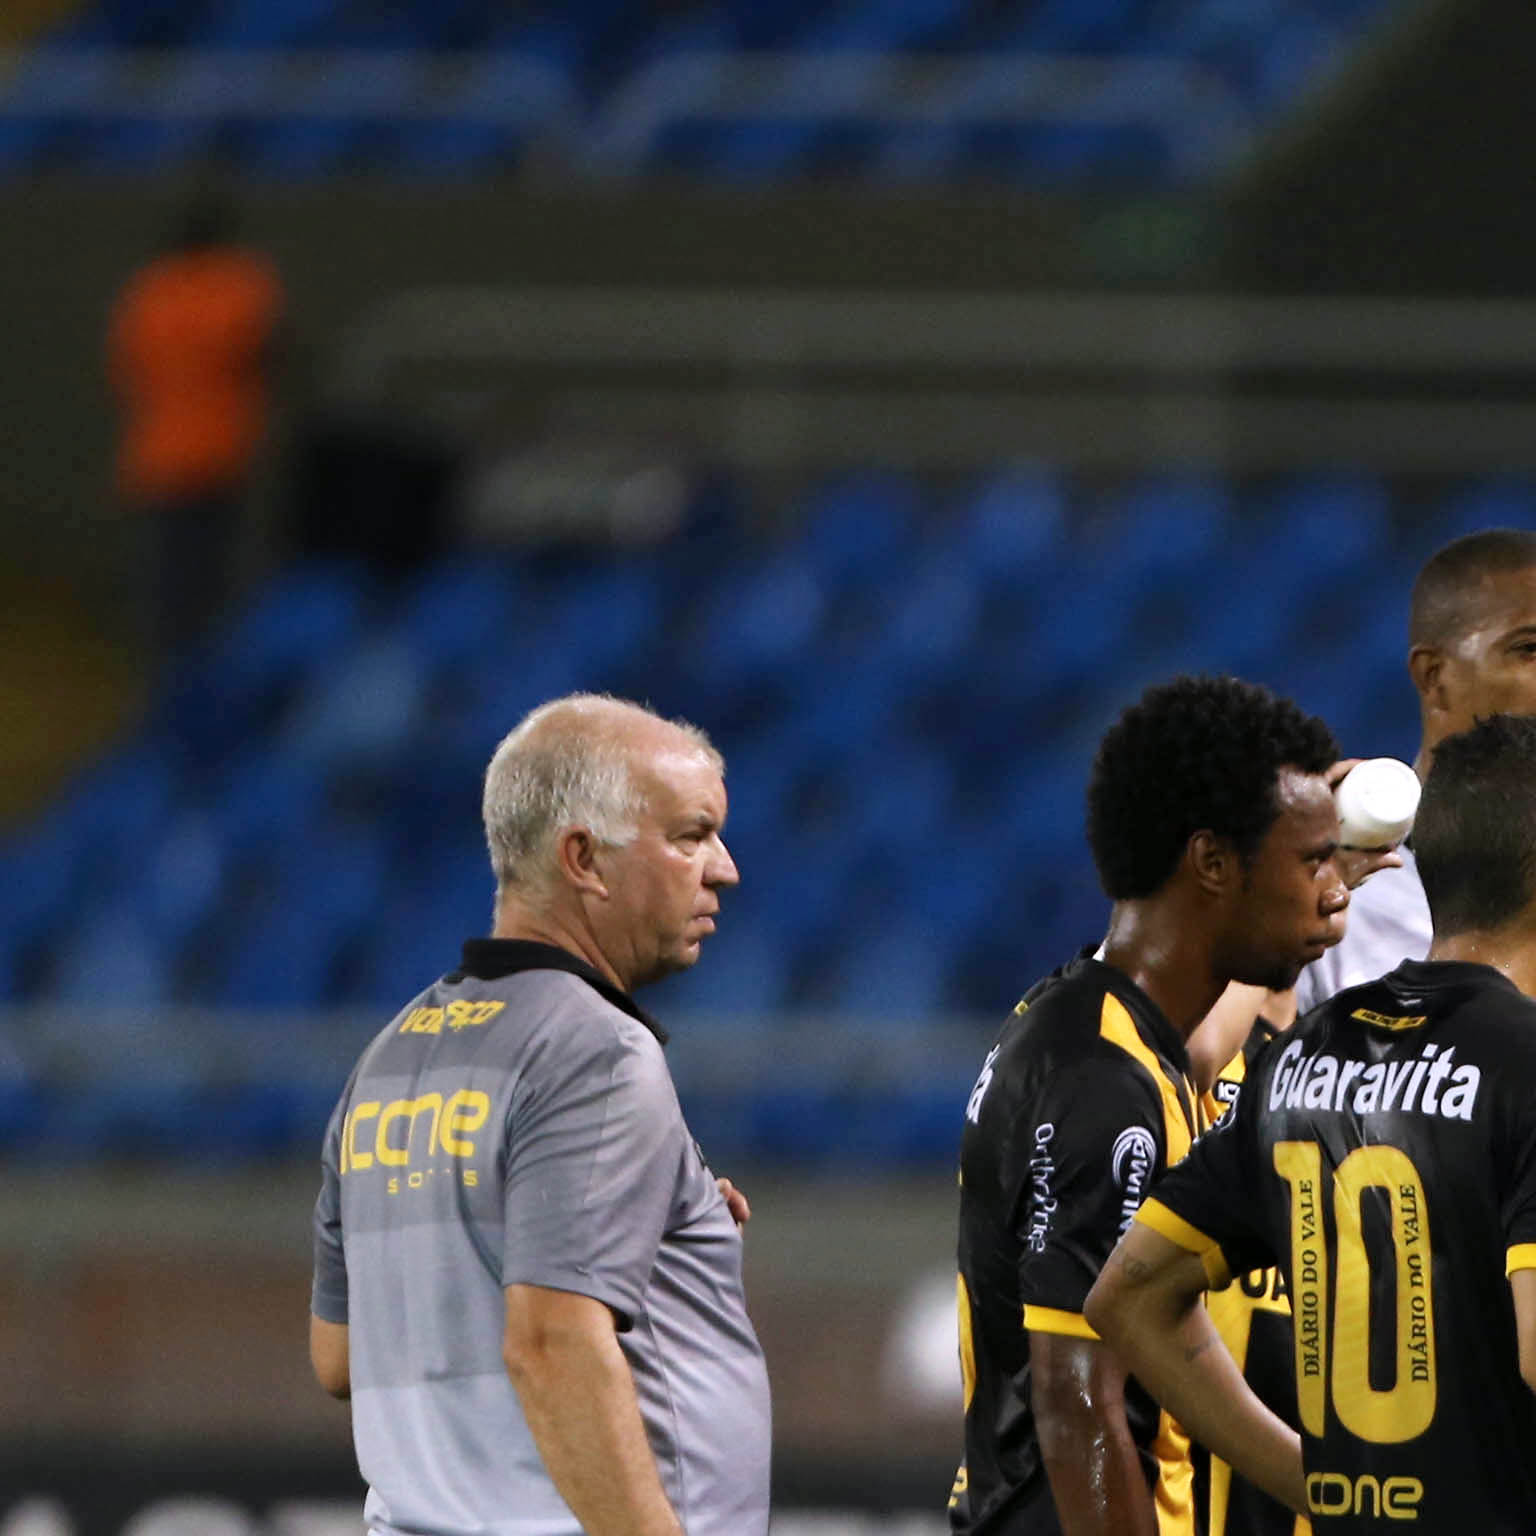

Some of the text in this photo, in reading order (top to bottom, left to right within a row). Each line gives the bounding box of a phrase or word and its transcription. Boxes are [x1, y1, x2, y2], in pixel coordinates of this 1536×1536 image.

[1268, 1039, 1481, 1121] Guaravita
[1273, 1140, 1437, 1444] 10
[1299, 1180, 1320, 1377] DIÁRIO DO VALE
[1400, 1184, 1430, 1383] DIÁRIO DO VALE
[1306, 1471, 1424, 1520] cone
